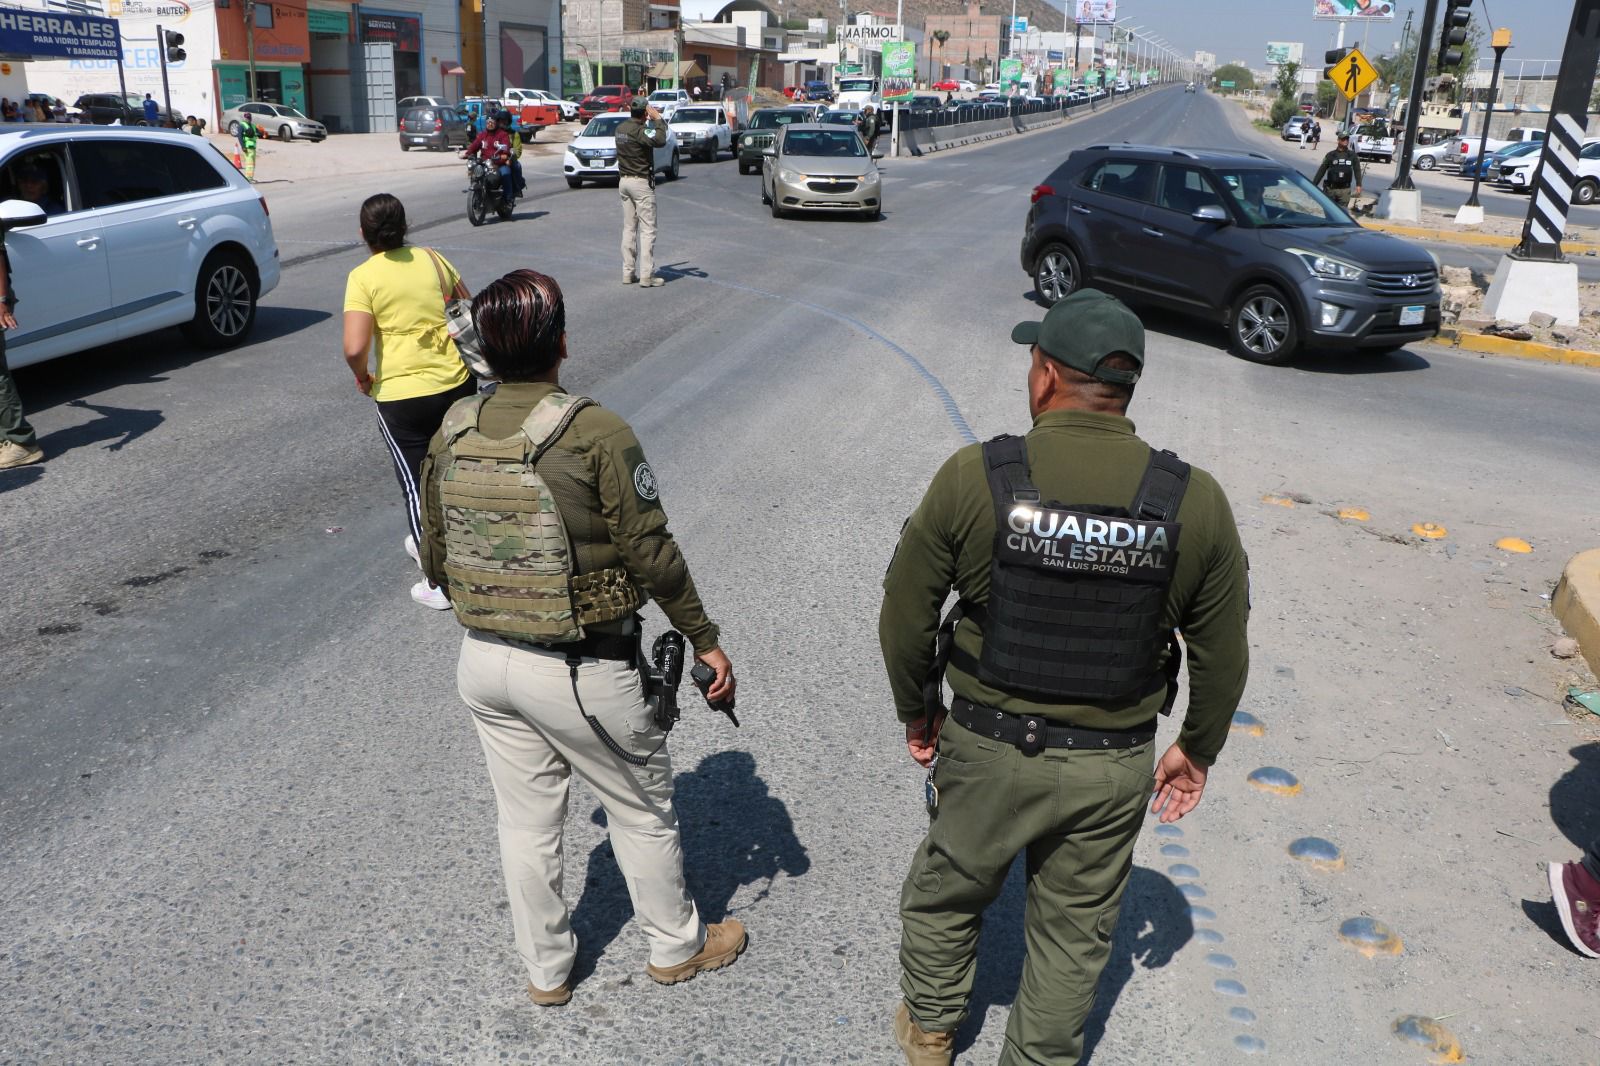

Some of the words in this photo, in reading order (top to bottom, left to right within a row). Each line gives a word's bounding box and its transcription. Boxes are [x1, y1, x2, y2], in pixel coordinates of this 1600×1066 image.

[157, 6, 189, 15] BAUTECH
[0, 13, 115, 39] HERRAJES
[845, 27, 898, 38] MARMOL
[33, 35, 54, 43] PARA
[55, 36, 79, 46] VIDRIO
[80, 38, 117, 47] TEMPLADO
[73, 47, 118, 57] BARANDALES
[1007, 507, 1170, 552] GUARDIA
[1006, 534, 1064, 557] CIVIL
[1069, 543, 1167, 569] ESTATAL
[1042, 557, 1065, 568] SAN
[1066, 561, 1089, 571] LUIS
